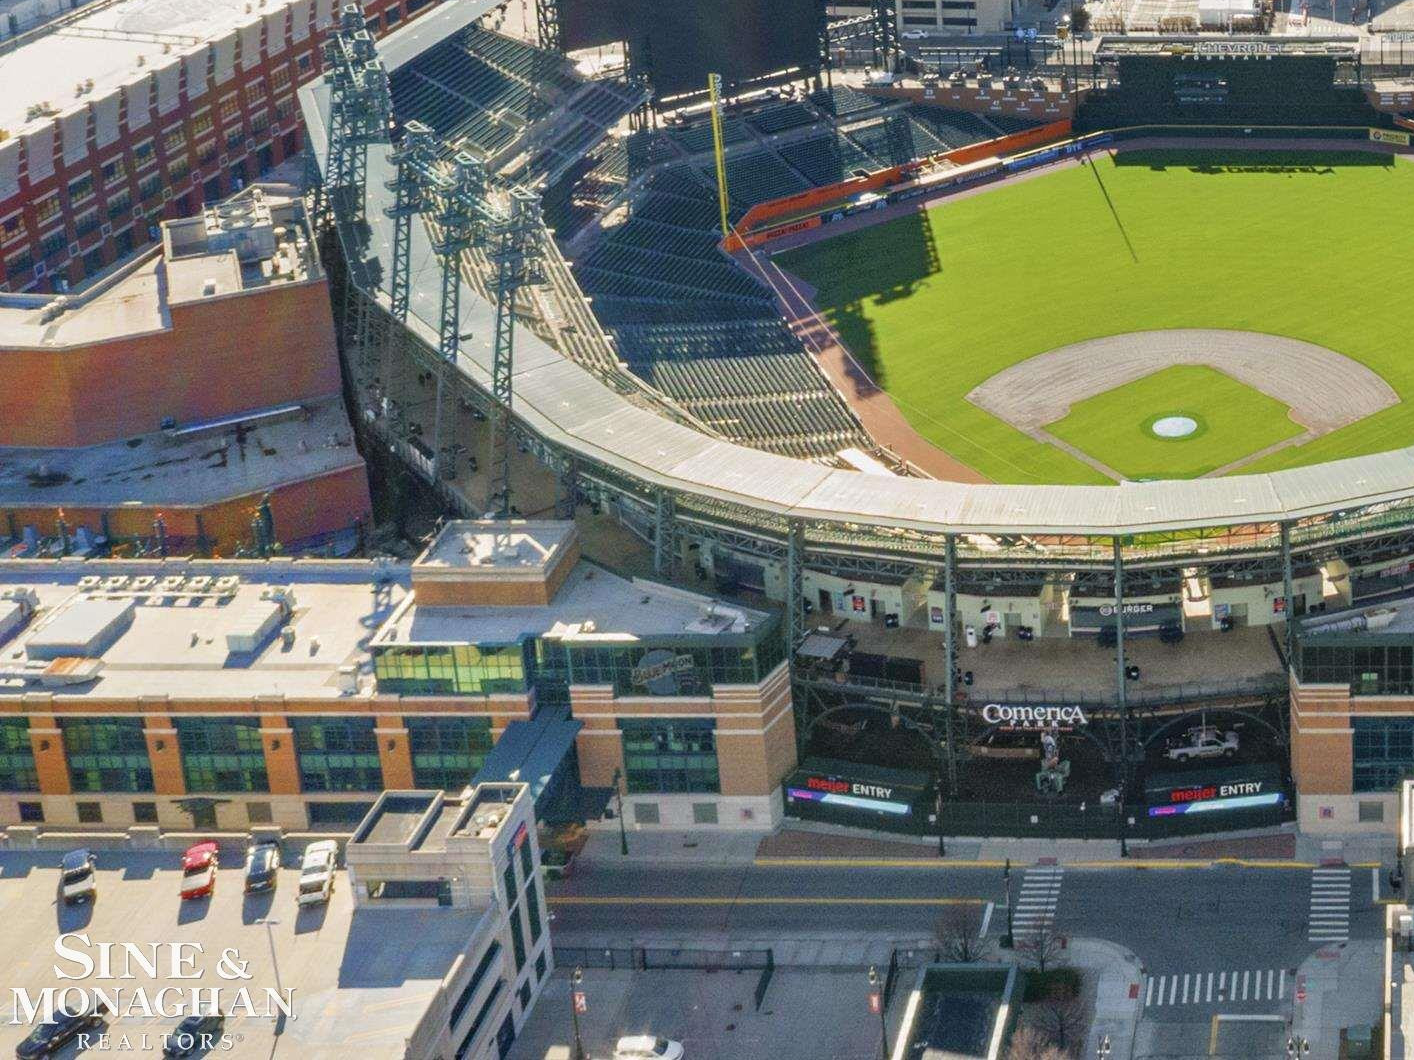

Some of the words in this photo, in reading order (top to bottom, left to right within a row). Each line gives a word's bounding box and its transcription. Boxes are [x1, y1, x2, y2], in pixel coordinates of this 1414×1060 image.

[1199, 43, 1282, 53] CHEVROLET
[852, 783, 892, 799] ENTRY
[1220, 781, 1262, 797] ENTRY
